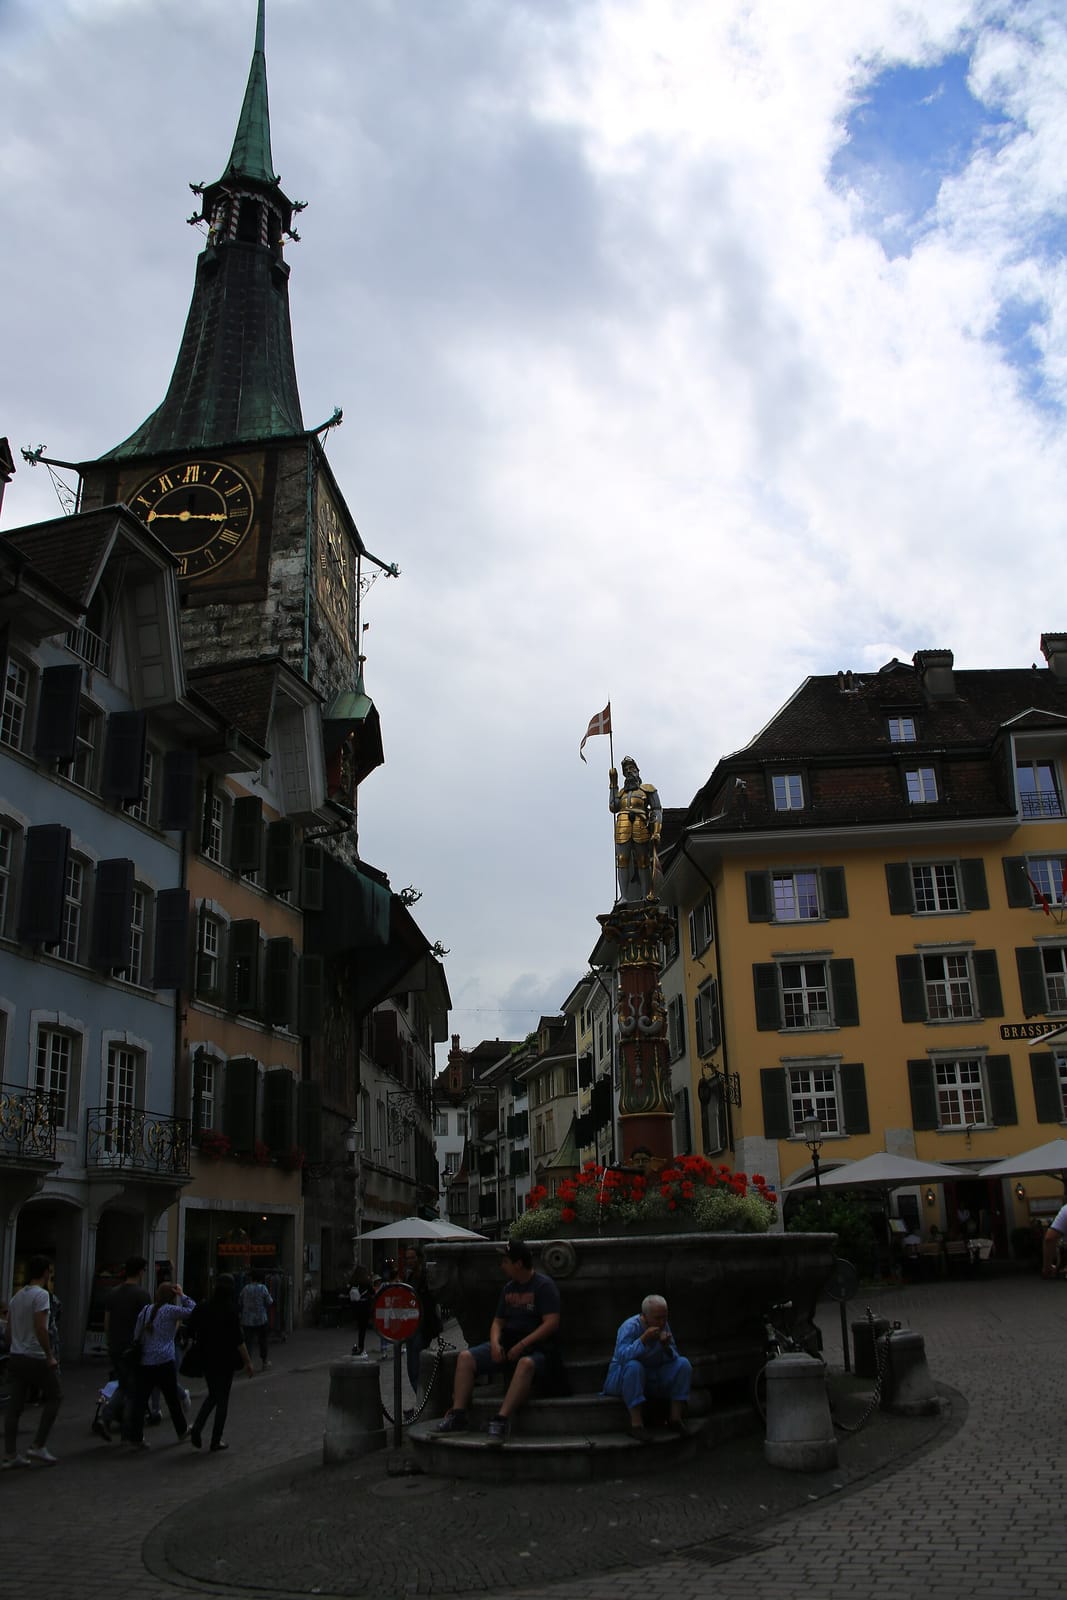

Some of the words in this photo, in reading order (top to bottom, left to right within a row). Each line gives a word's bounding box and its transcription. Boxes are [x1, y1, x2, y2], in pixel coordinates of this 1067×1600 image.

[182, 464, 200, 484] XII
[210, 468, 224, 486] I
[158, 474, 174, 494] XI
[224, 483, 244, 497] II
[137, 496, 152, 508] X
[229, 507, 248, 518] III
